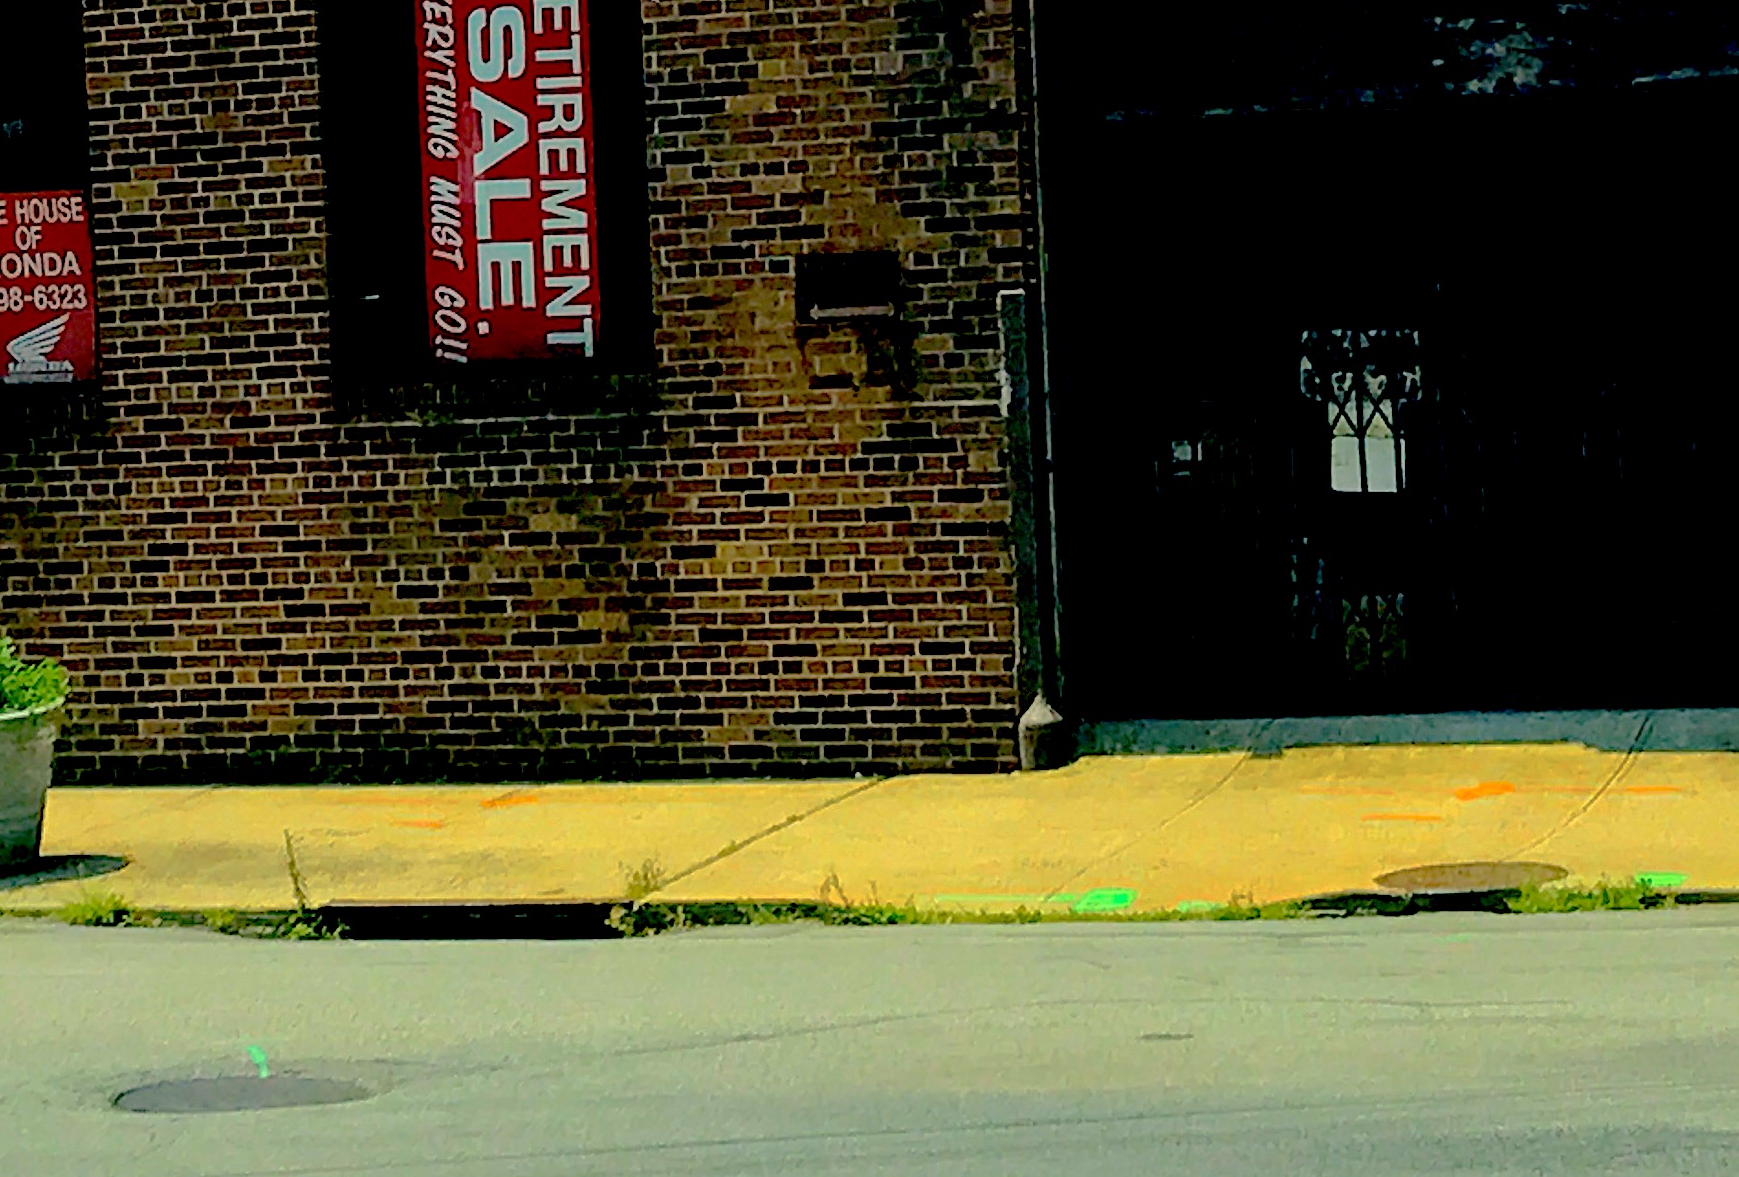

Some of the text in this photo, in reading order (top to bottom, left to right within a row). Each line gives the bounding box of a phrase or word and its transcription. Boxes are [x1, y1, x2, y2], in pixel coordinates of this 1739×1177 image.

[467, 5, 536, 335] SALE.
[14, 196, 85, 225] HOUSE
[15, 225, 43, 251] OF
[429, 175, 465, 271] MUST
[434, 285, 469, 364] GO!!
